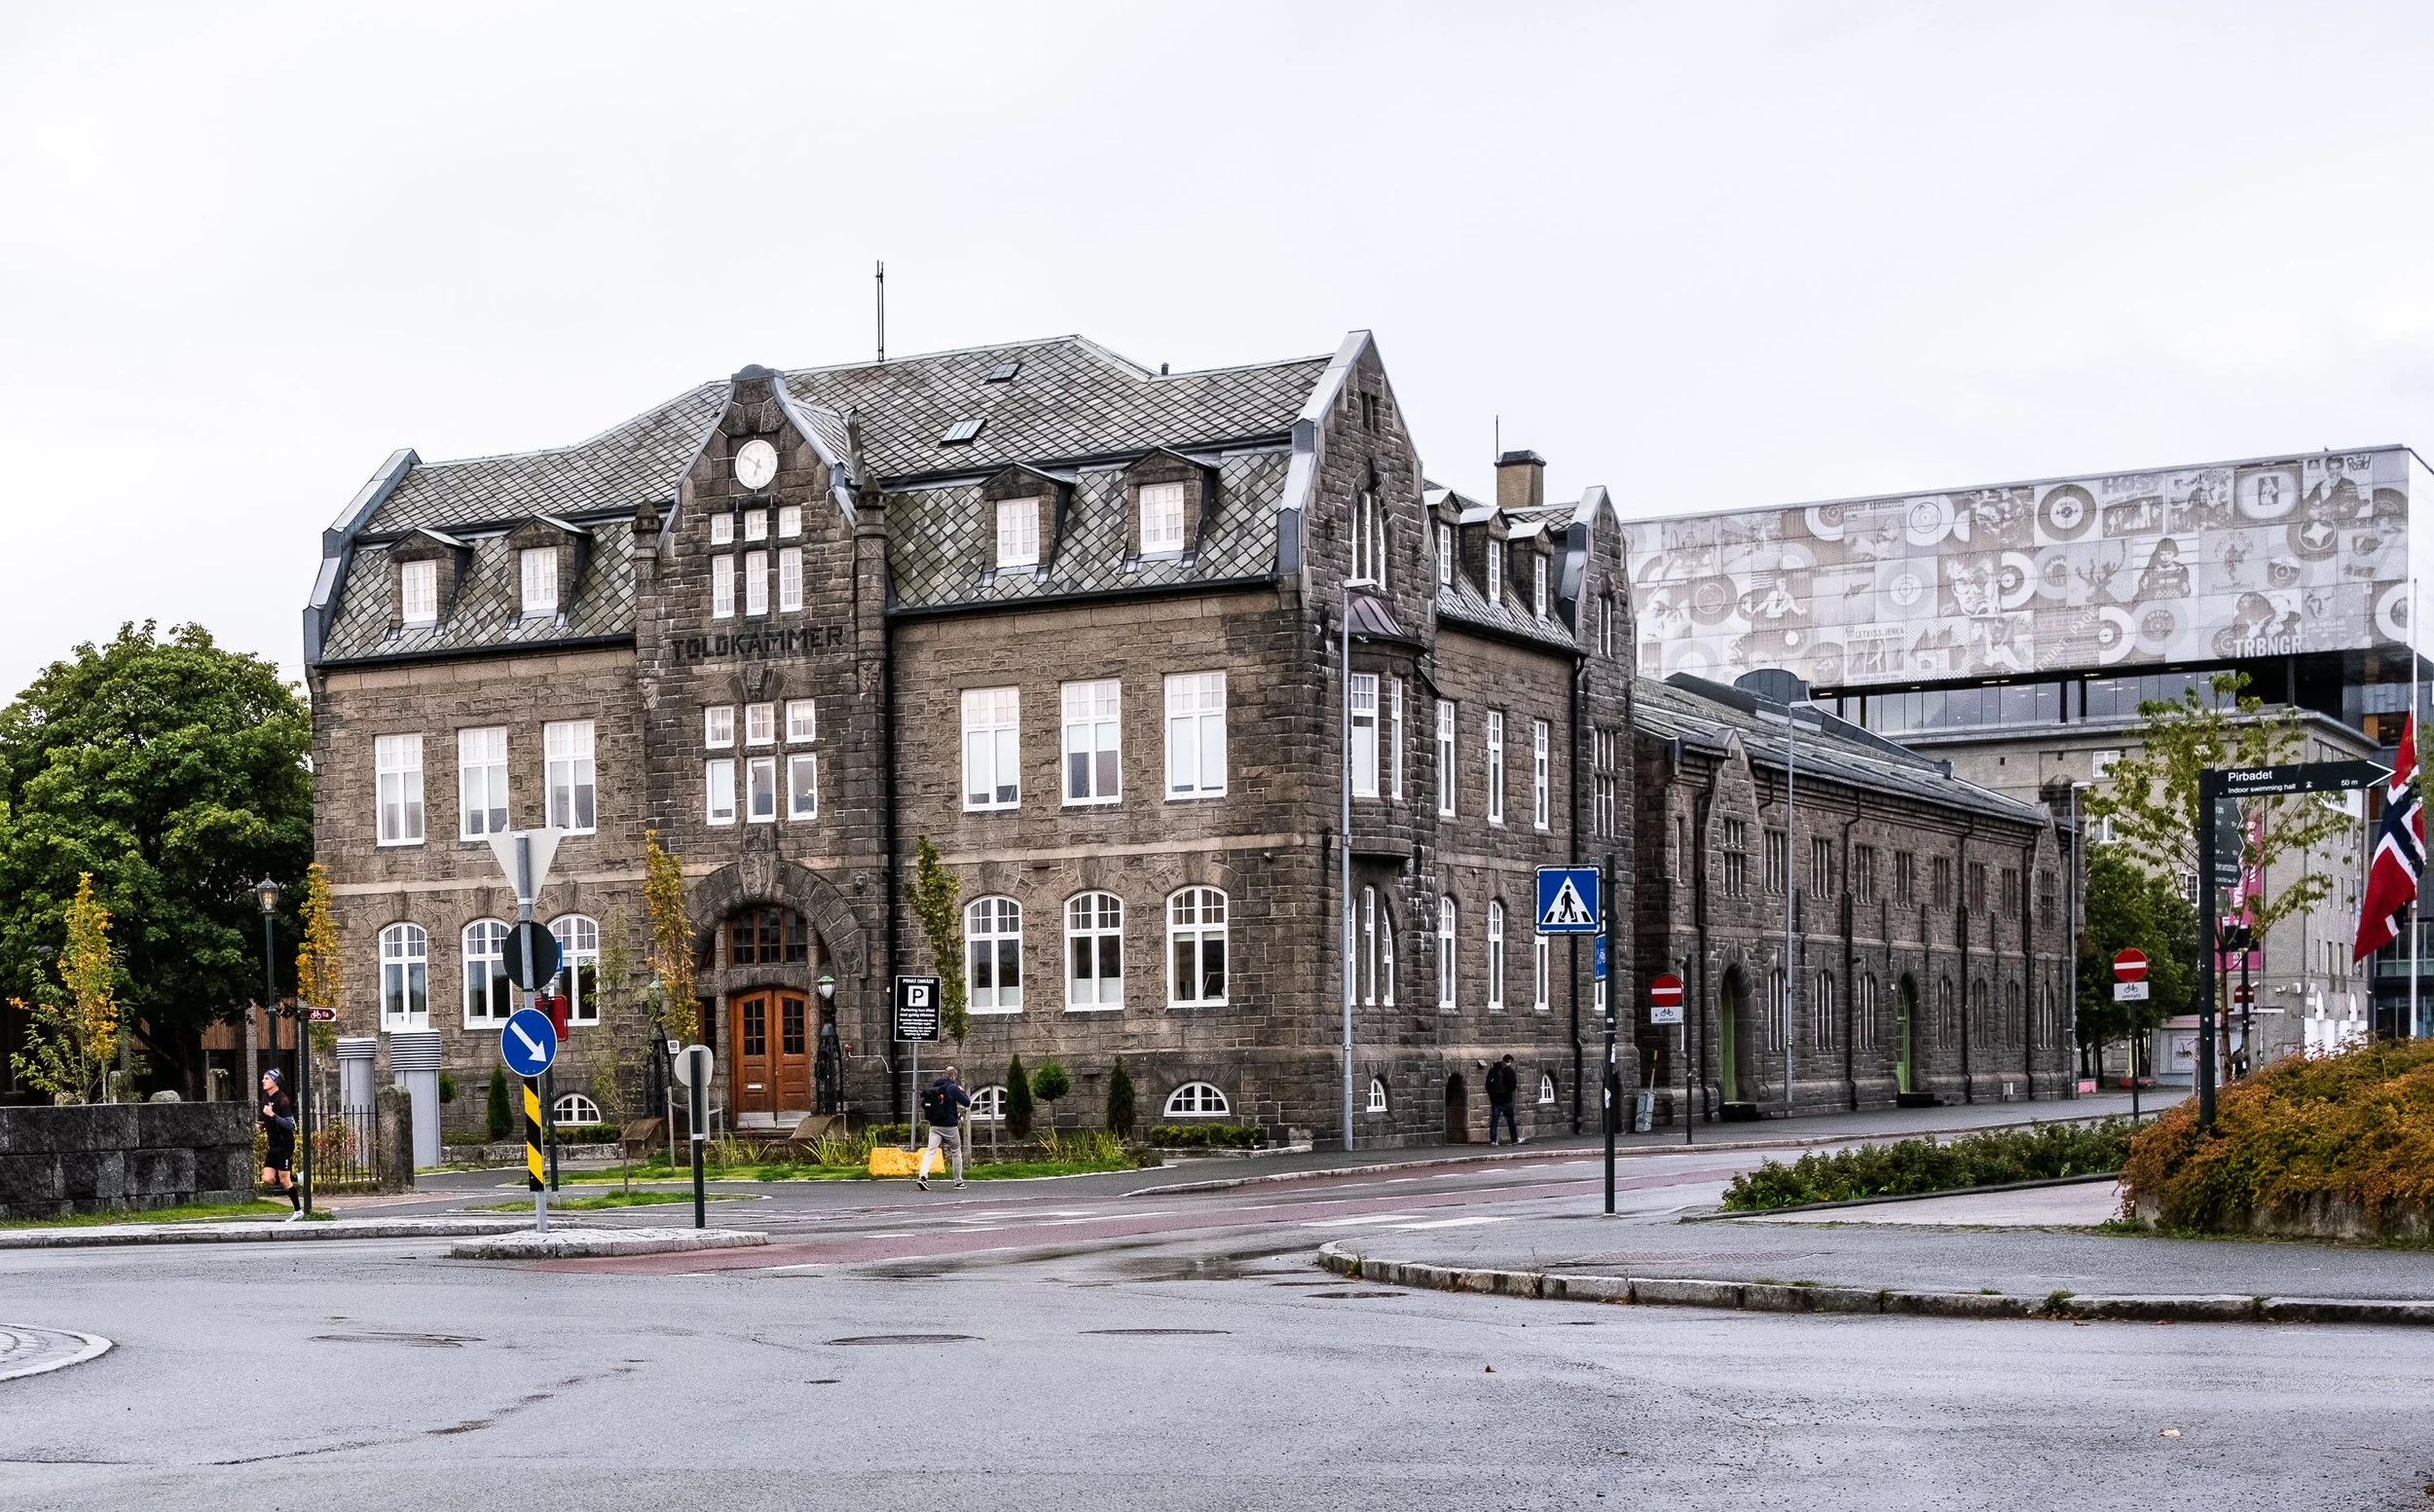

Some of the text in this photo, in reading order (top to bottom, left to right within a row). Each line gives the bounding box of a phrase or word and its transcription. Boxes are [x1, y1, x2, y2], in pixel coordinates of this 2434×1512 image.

[672, 625, 844, 659] TOLDKAMMER
[2233, 635, 2302, 658] TRBNGR
[2228, 770, 2272, 782] Pirbadet
[912, 988, 924, 1004] P
